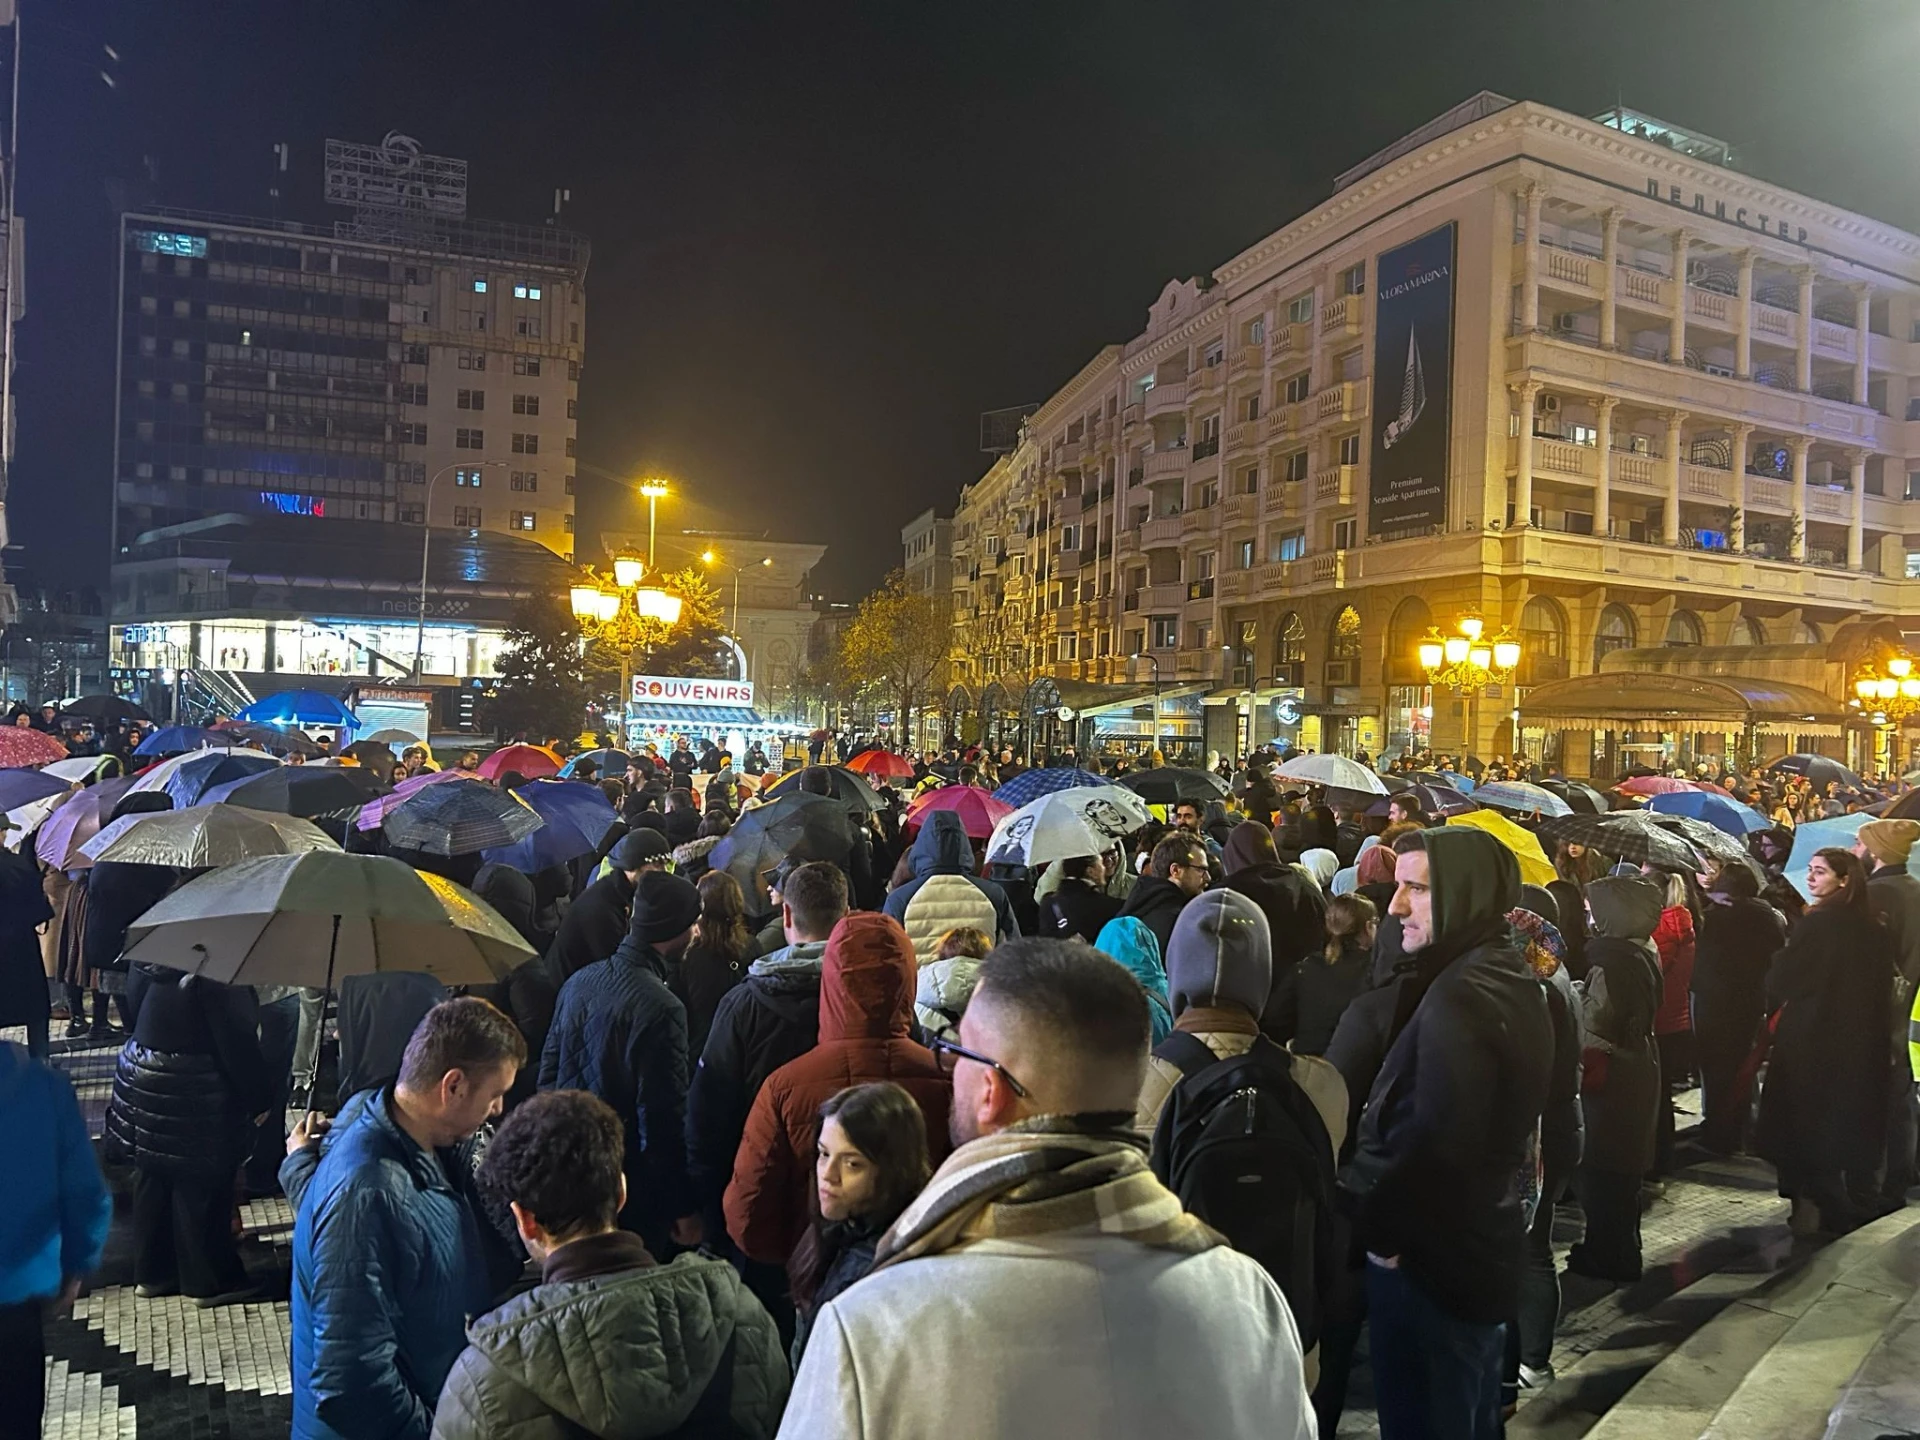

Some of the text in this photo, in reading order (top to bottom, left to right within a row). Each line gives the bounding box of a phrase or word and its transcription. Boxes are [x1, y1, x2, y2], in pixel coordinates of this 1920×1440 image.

[1646, 178, 1808, 243] ПЕЛИСТЕР
[1390, 477, 1423, 489] Premium
[1373, 486, 1441, 504] Seaside Apartments
[635, 680, 751, 701] SOUVENIRS
